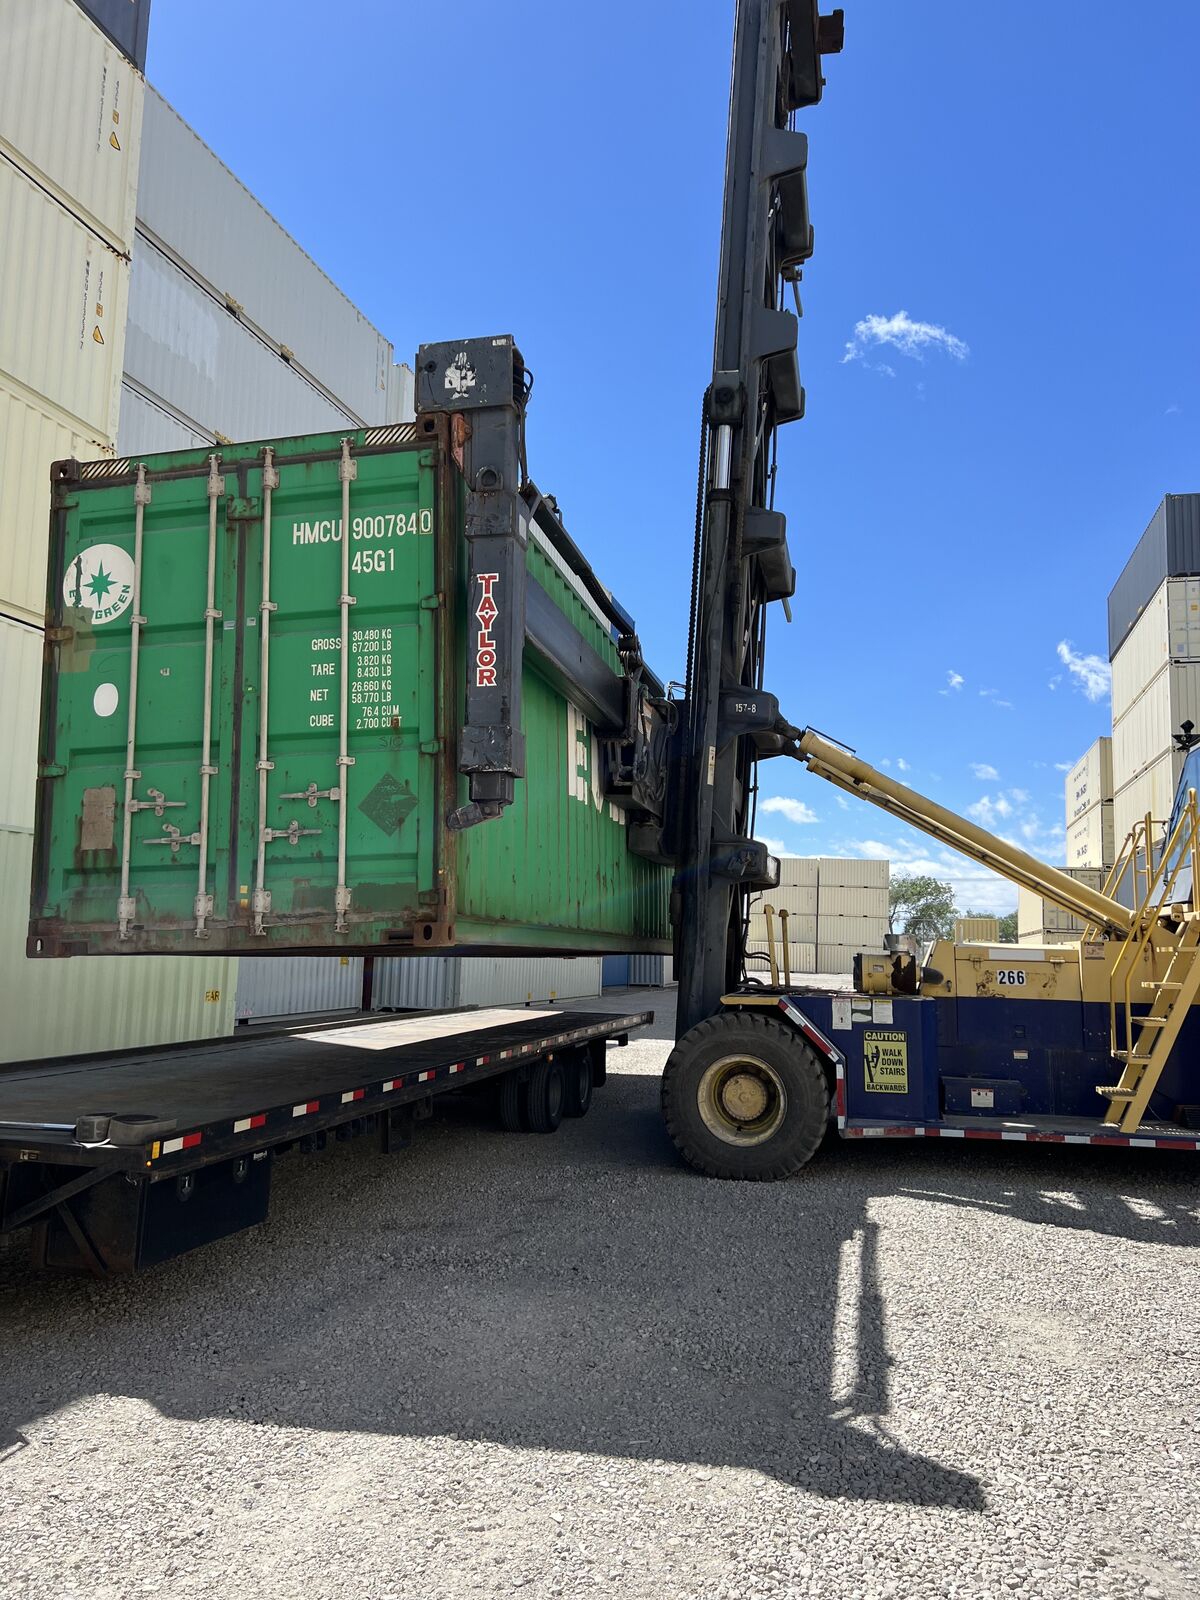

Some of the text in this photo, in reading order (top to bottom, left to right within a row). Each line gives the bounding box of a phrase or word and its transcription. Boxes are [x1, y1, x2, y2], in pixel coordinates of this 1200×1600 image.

[293, 519, 343, 545] HMCU
[351, 548, 395, 574] 45G1
[352, 628, 392, 641] 30.480 KG
[475, 573, 499, 686] TAYLOR
[311, 637, 392, 653] GROSS 67.200 LB
[357, 653, 392, 666] 3.820 KG
[311, 663, 392, 678] TARE 8.430 LB
[351, 679, 392, 692] 26.660 KG
[310, 689, 392, 704] NET 58.770 LB
[735, 703, 757, 713] 157-8
[309, 714, 335, 727] CUBE
[356, 717, 379, 730] 2.700
[997, 969, 1026, 986] 266
[865, 1032, 905, 1042] CAUTION
[881, 1048, 903, 1057] WALK
[881, 1058, 904, 1067] DOWN
[879, 1067, 906, 1077] STAIRS
[866, 1083, 906, 1093] BACKWARDS
